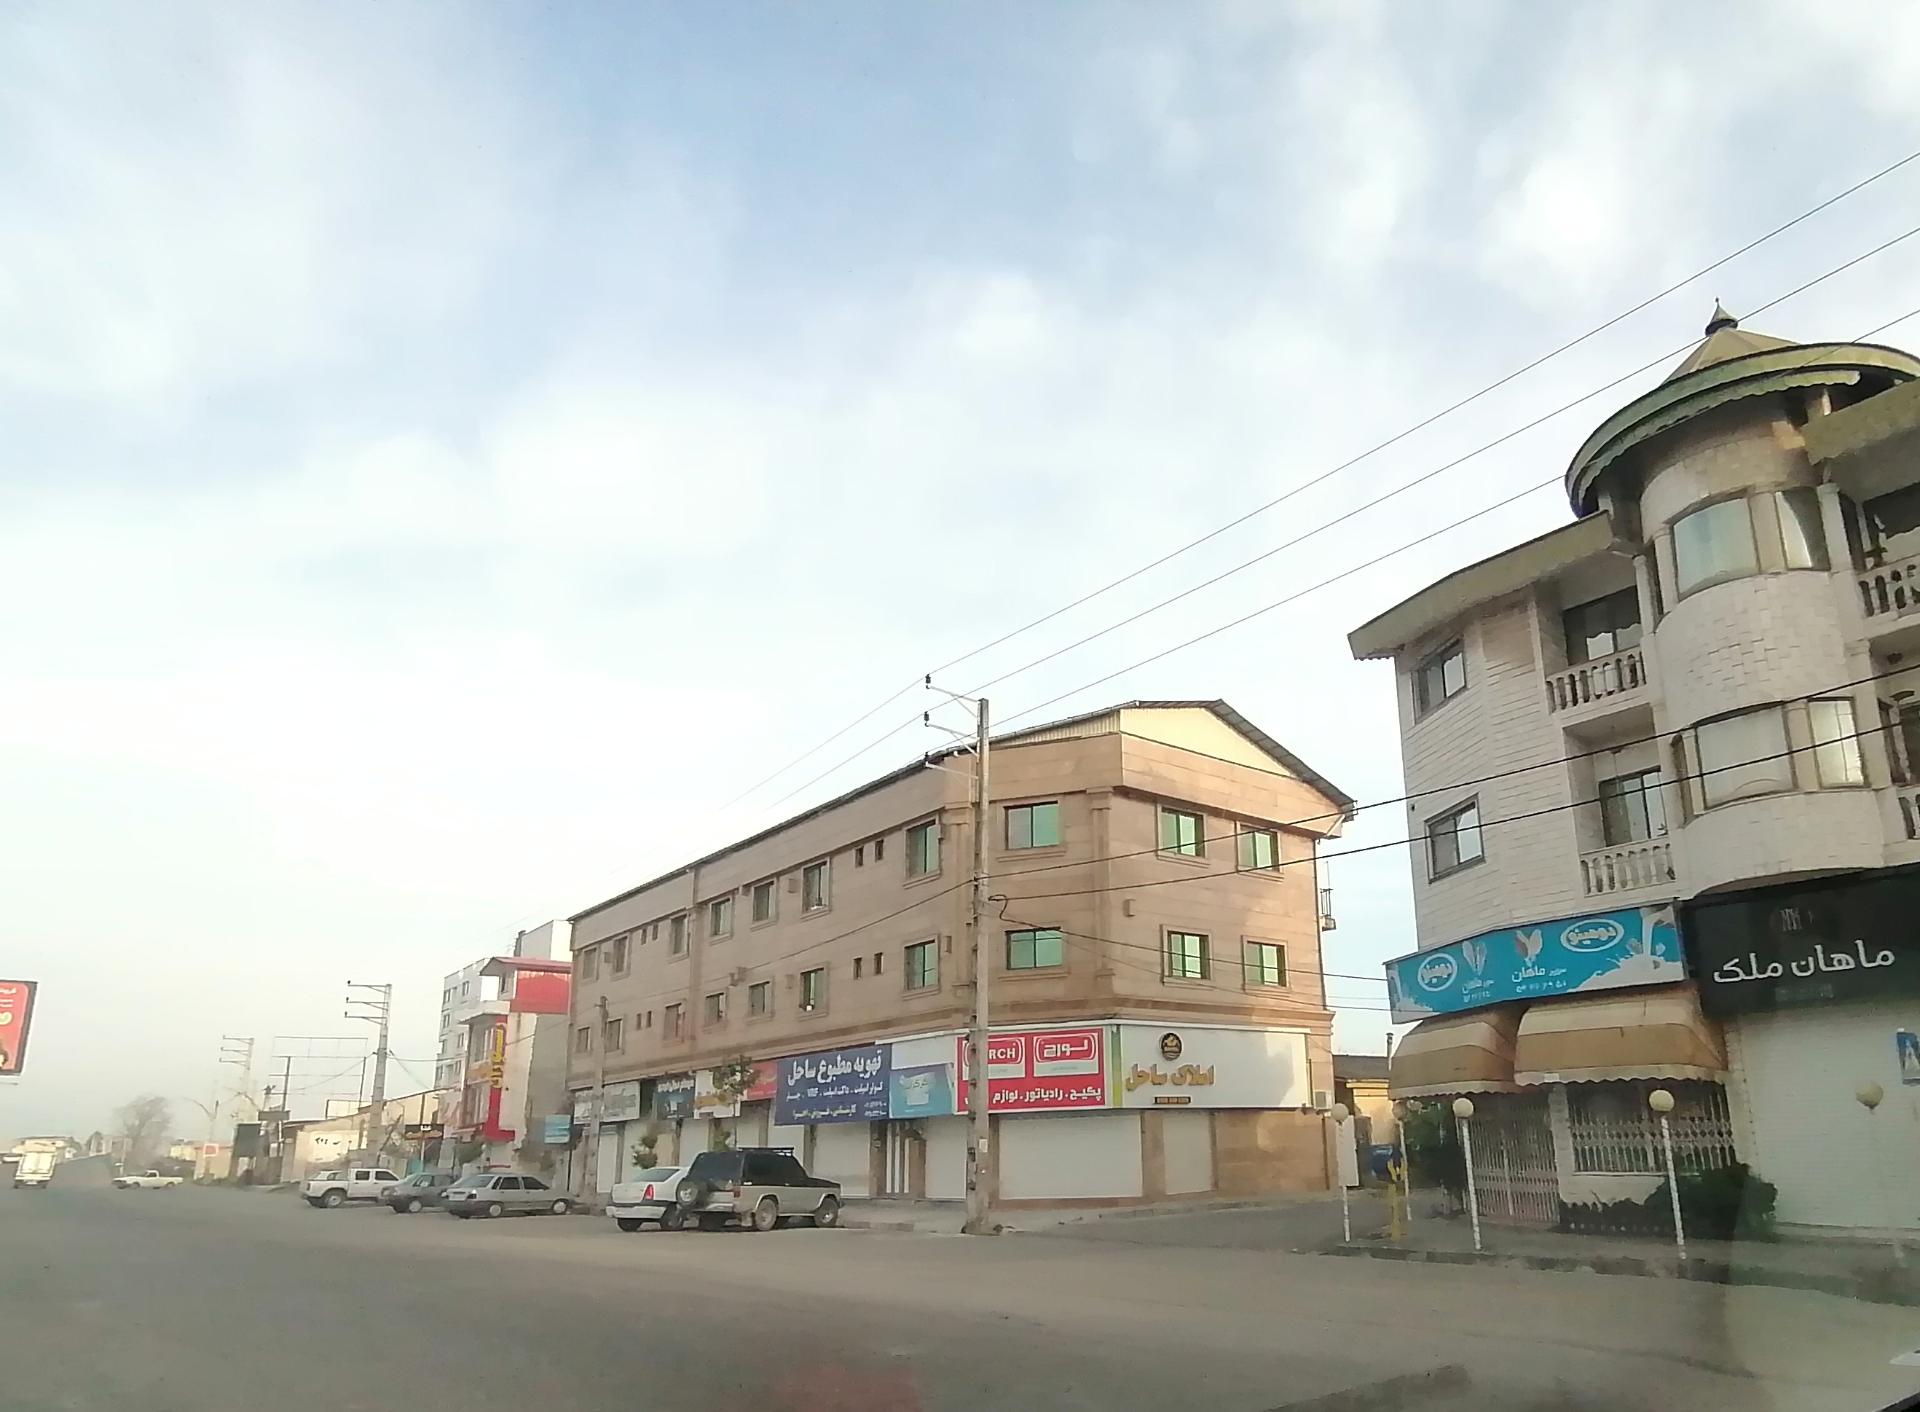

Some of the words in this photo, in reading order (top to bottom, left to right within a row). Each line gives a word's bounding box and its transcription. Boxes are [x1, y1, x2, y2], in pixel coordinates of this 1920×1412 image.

[1567, 926, 1617, 945] دومینو
[1712, 952, 1784, 983] ملک
[1790, 938, 1896, 977] ماهان
[1511, 965, 1546, 983] ماهان
[787, 1058, 817, 1087] ساحل
[817, 1053, 852, 1083] مطبوع
[853, 1049, 883, 1079] تهویه
[1171, 1064, 1215, 1086] املاک
[1125, 1063, 1168, 1092] ساحل
[992, 1089, 1019, 1105] لوازم
[1024, 1087, 1063, 1102] رادیاتور
[1070, 1086, 1102, 1102] پکیج
